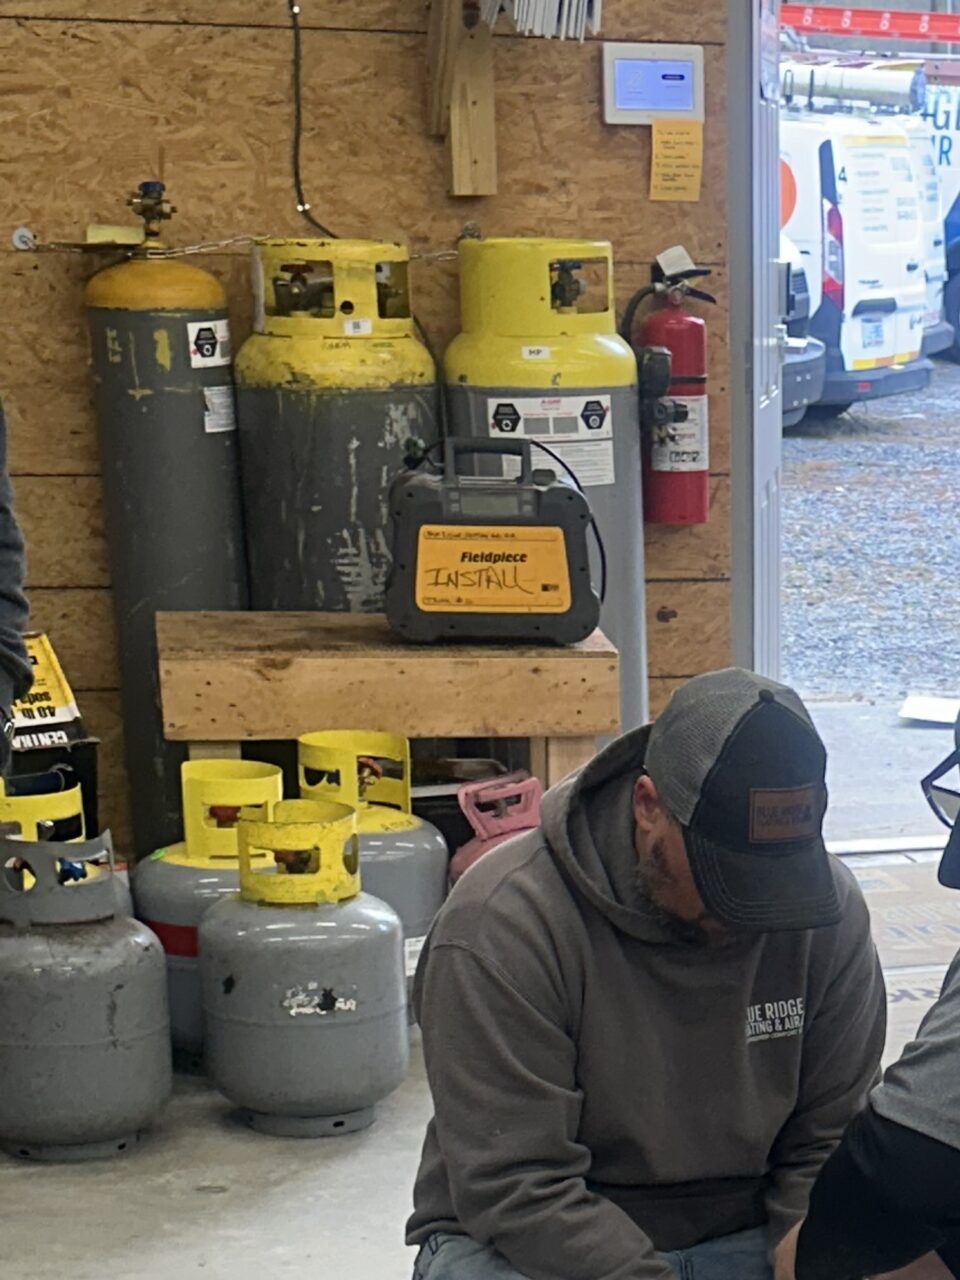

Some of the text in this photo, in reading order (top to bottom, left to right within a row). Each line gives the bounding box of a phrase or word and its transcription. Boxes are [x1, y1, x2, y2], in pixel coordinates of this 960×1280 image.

[460, 551, 528, 564] Fieldpiece
[424, 565, 534, 595] INSTALL
[12, 731, 68, 748] CENTRA
[747, 997, 804, 1022] UE RIDGE
[745, 1020, 773, 1037] ATING
[784, 1015, 800, 1030] AIR
